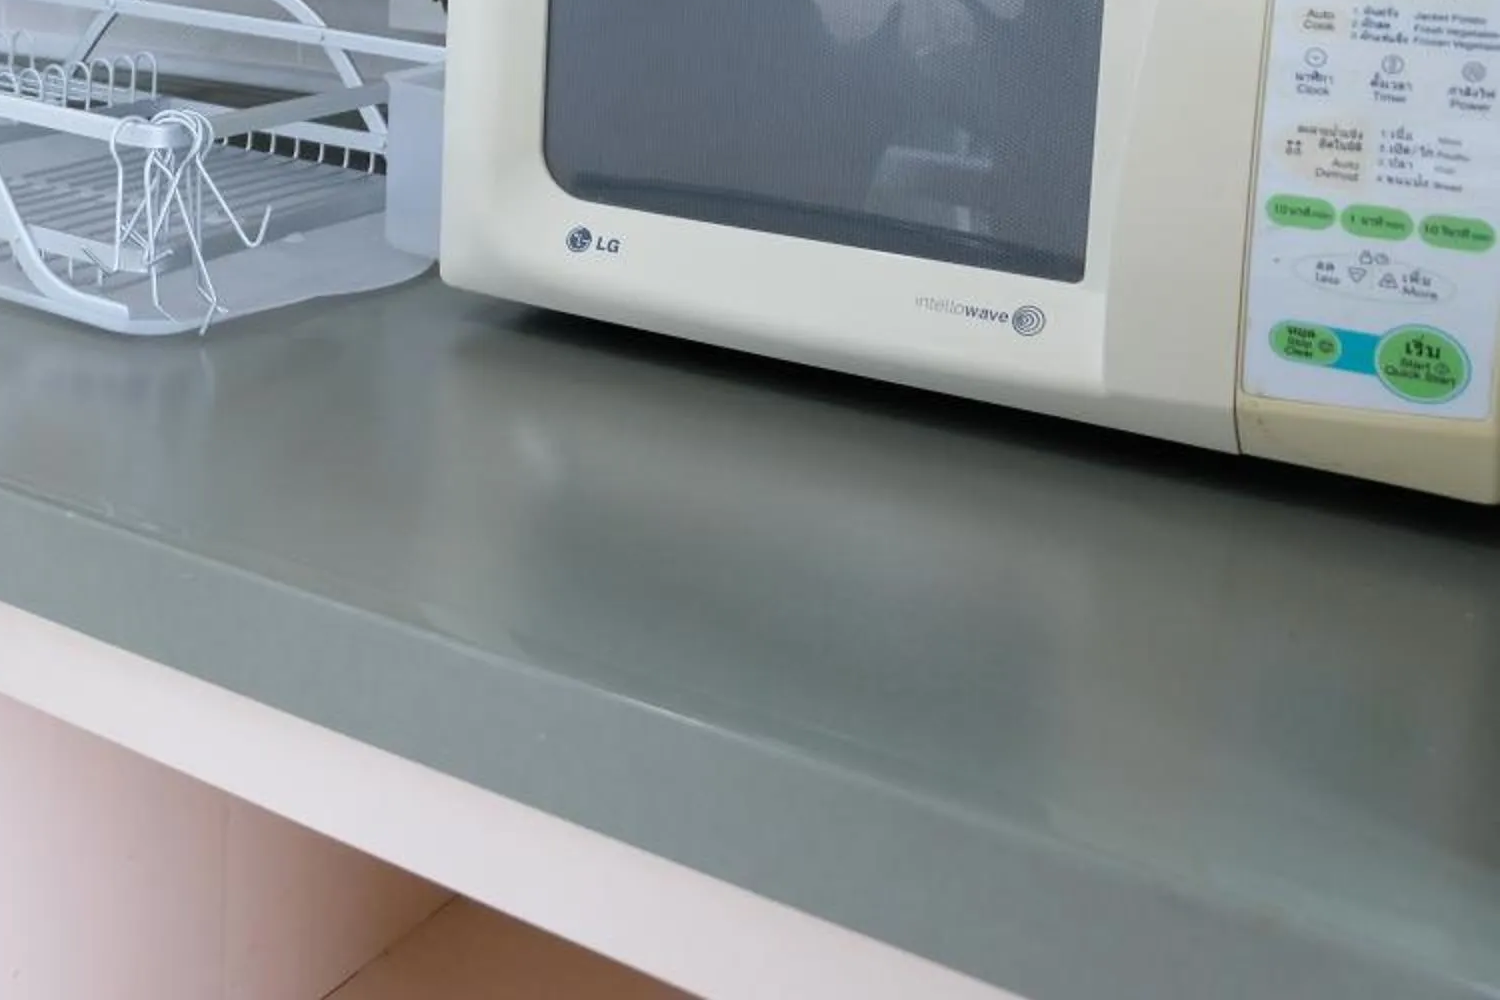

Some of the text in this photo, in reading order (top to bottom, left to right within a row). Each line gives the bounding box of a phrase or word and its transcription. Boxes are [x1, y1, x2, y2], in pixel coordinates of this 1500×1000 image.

[1296, 83, 1330, 96] Clock
[596, 236, 621, 253] LG
[1402, 286, 1438, 300] More
